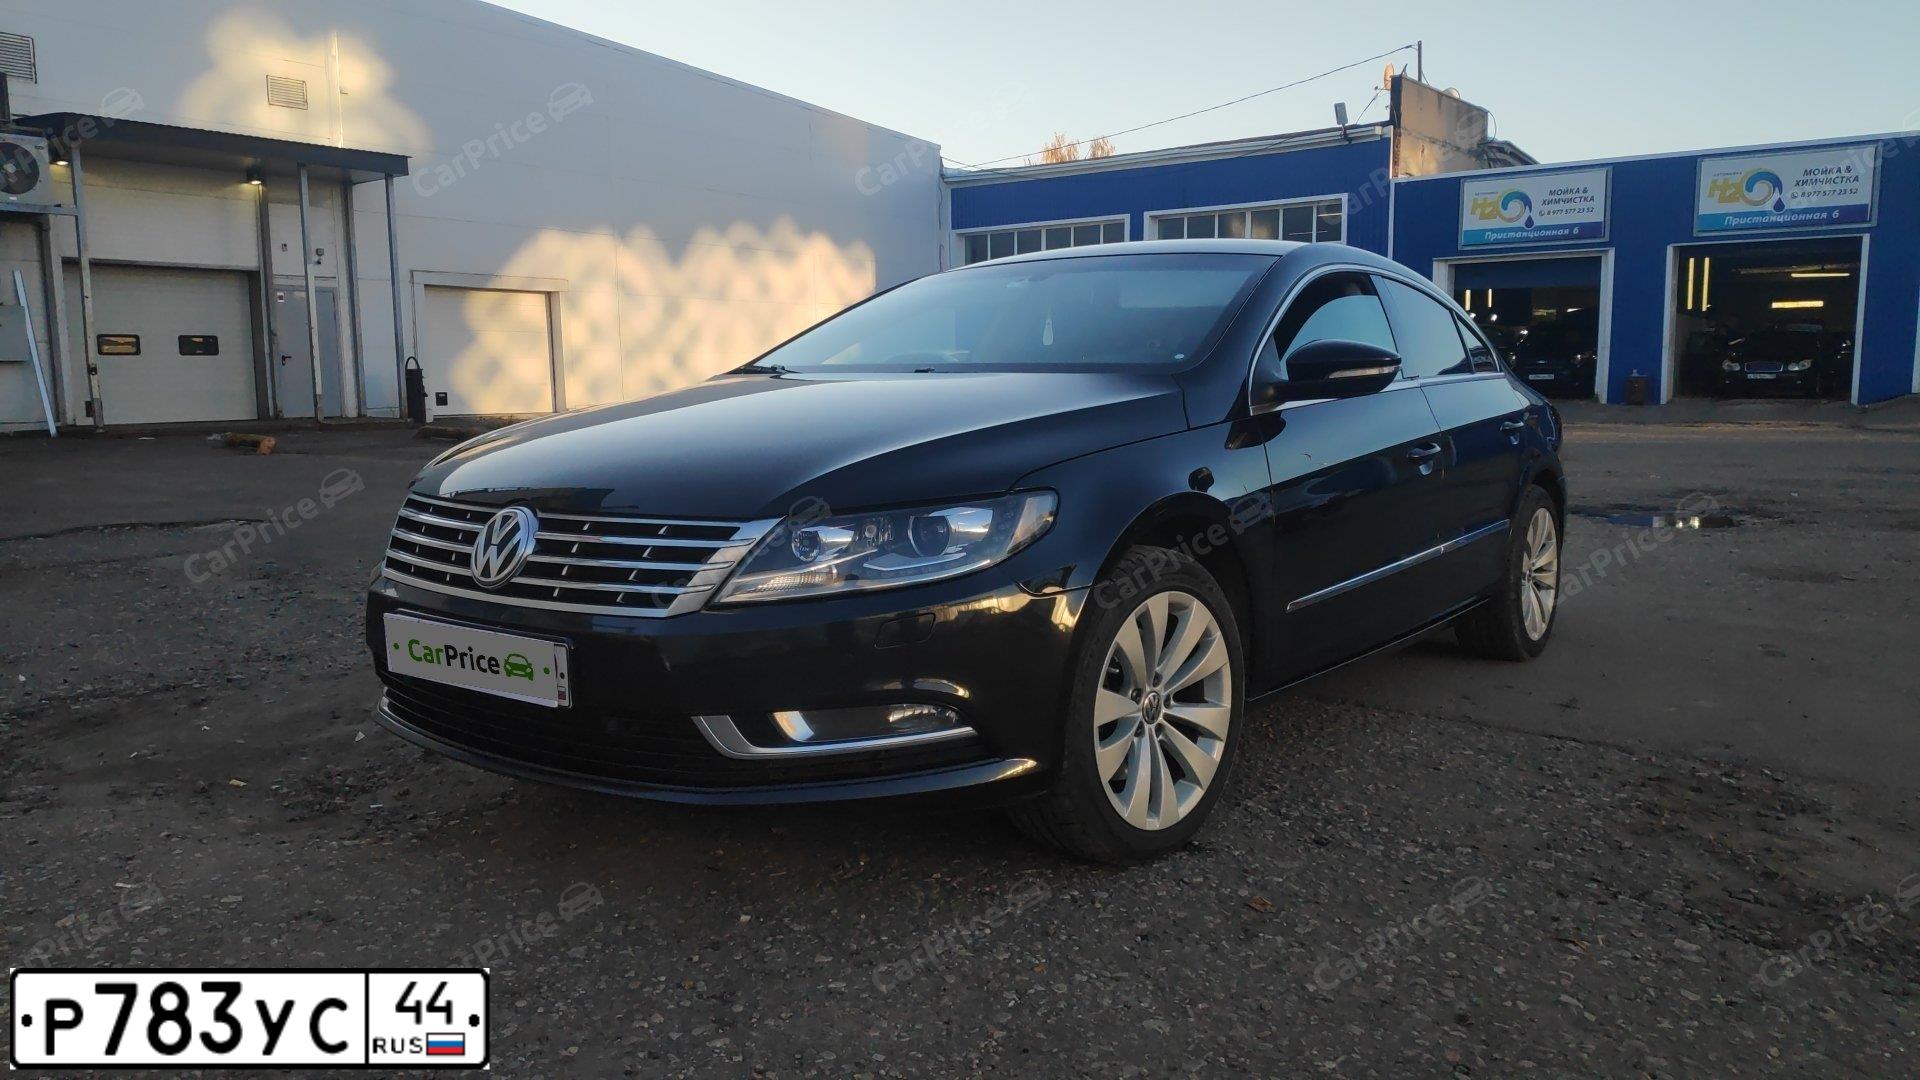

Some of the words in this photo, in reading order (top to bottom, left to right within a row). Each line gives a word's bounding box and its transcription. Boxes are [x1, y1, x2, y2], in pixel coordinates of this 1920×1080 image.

[1803, 166, 1842, 177] МОЙКА
[1794, 175, 1859, 187] ХИМЧИСТКА
[1549, 186, 1580, 196] МОЙКА
[1541, 195, 1595, 206] ХИМЧИСТКА
[1724, 212, 1828, 227] Пристанционная
[1832, 209, 1840, 219] 6
[1573, 226, 1580, 235] 6
